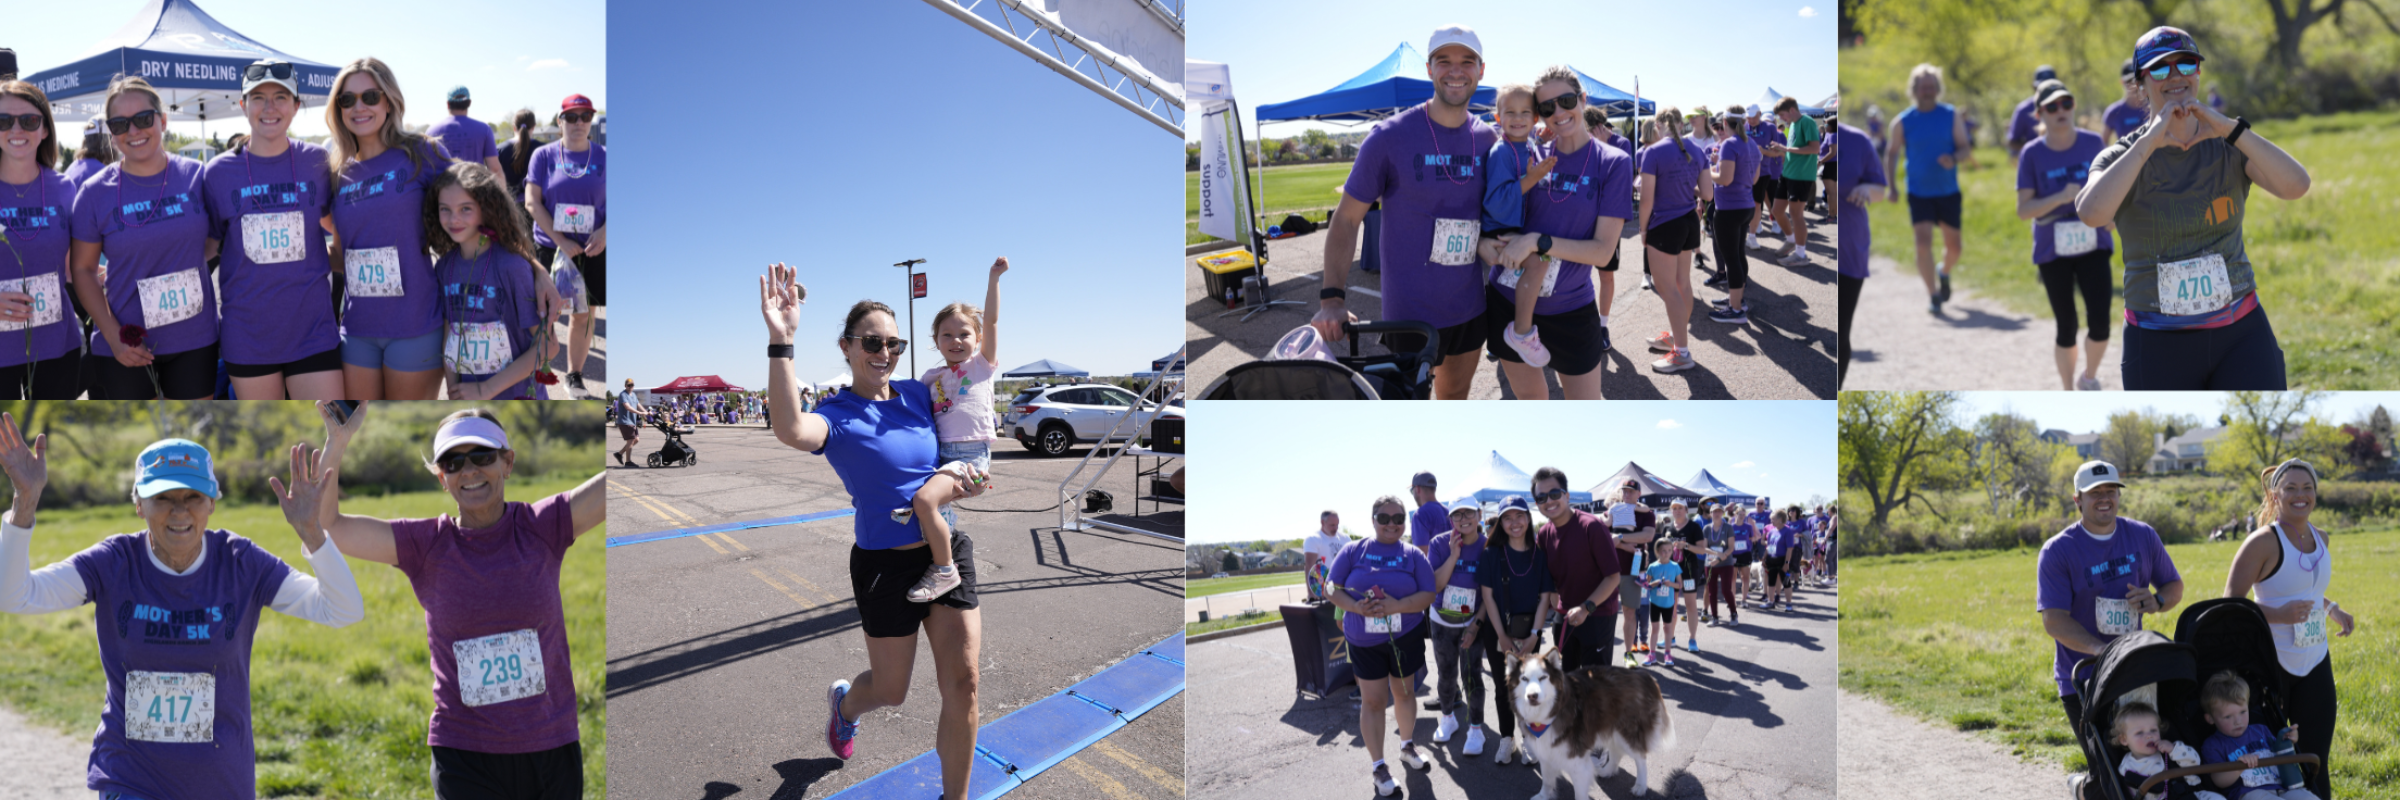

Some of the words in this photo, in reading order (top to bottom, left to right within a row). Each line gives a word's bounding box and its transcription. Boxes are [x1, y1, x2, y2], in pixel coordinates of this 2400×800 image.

[141, 60, 170, 78] DRY
[174, 62, 237, 81] NEEDLING
[46, 71, 79, 94] MEDICINE
[1425, 154, 1481, 166] MOTHERS
[240, 181, 308, 198] MOTHER'S
[339, 170, 396, 196] MOTHER'S
[369, 181, 384, 195] 5K
[1202, 164, 1214, 218] support
[0, 206, 57, 218] OTHER'S
[122, 193, 190, 215] MOTHER'S
[165, 203, 184, 216] 5K
[259, 227, 290, 249] 165
[1446, 235, 1470, 253] 661
[2066, 231, 2086, 246] 314
[358, 264, 386, 284] 479
[2177, 275, 2213, 300] 470
[158, 287, 188, 311] 481
[460, 340, 490, 360] 477
[2091, 553, 2136, 575] MOTHER'S
[2118, 563, 2131, 575] 5K
[1451, 594, 1468, 606] 640
[133, 603, 223, 623] MOTHER'S
[2106, 610, 2130, 626] 306
[144, 621, 182, 639] DAY
[186, 624, 211, 639] 5K
[2304, 621, 2321, 637] 308
[479, 653, 522, 687] 239
[147, 695, 192, 723] 417
